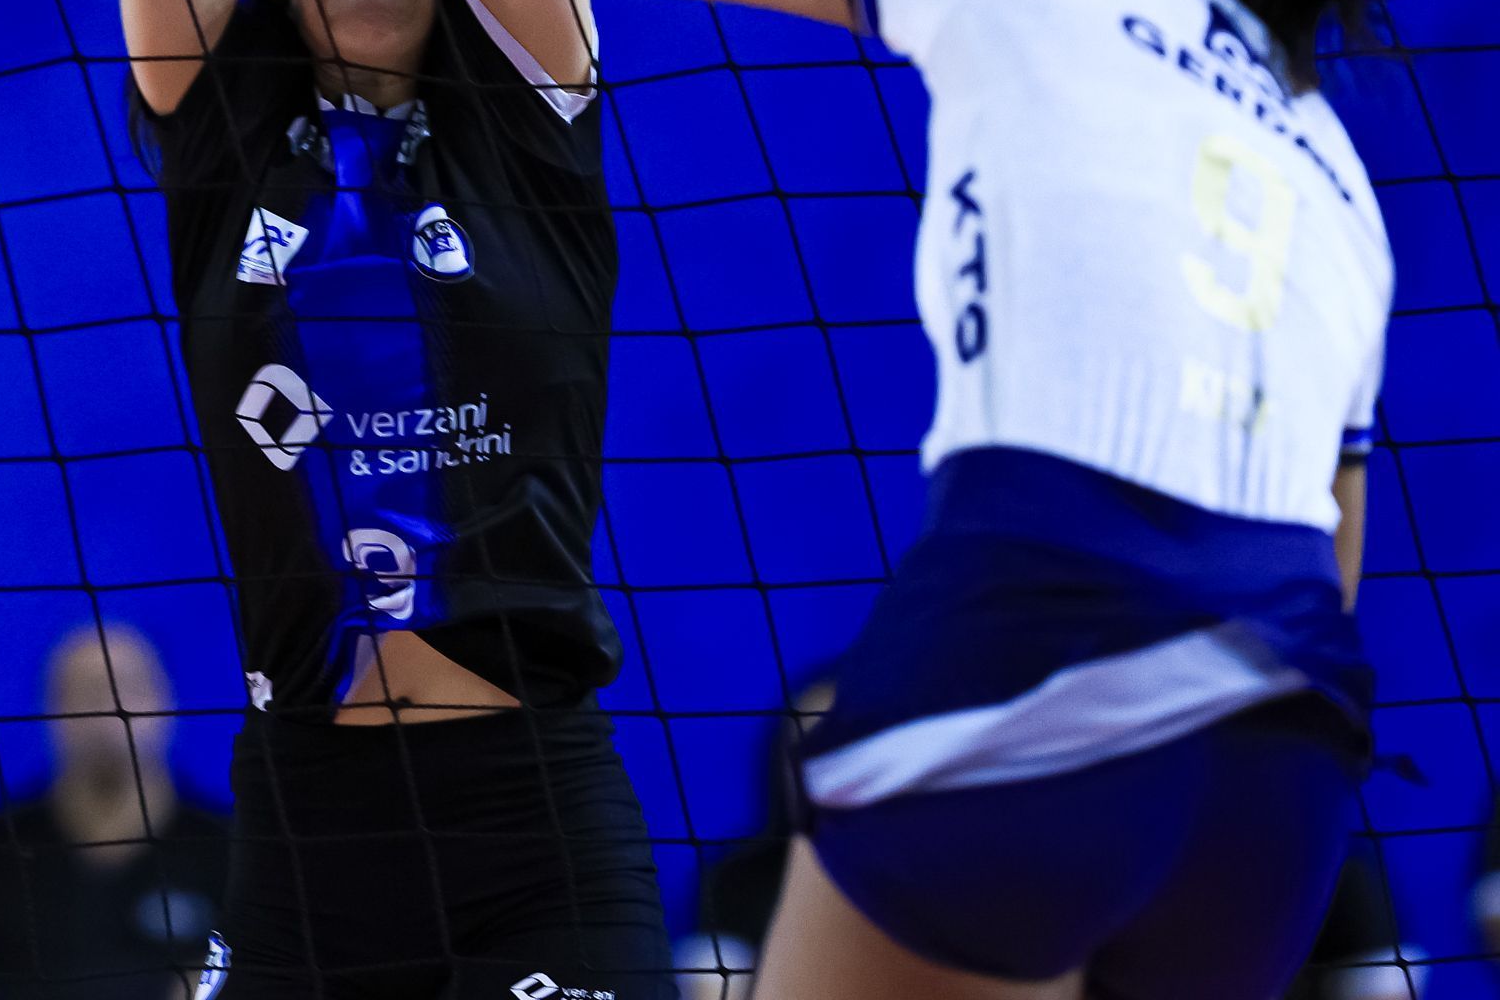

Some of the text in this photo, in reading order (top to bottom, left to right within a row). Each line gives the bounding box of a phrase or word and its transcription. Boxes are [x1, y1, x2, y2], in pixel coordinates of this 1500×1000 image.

[1184, 134, 1297, 332] 9
[948, 166, 988, 365] KTO
[345, 392, 488, 439] verzani
[349, 448, 373, 477] &
[561, 986, 616, 1000] verani
